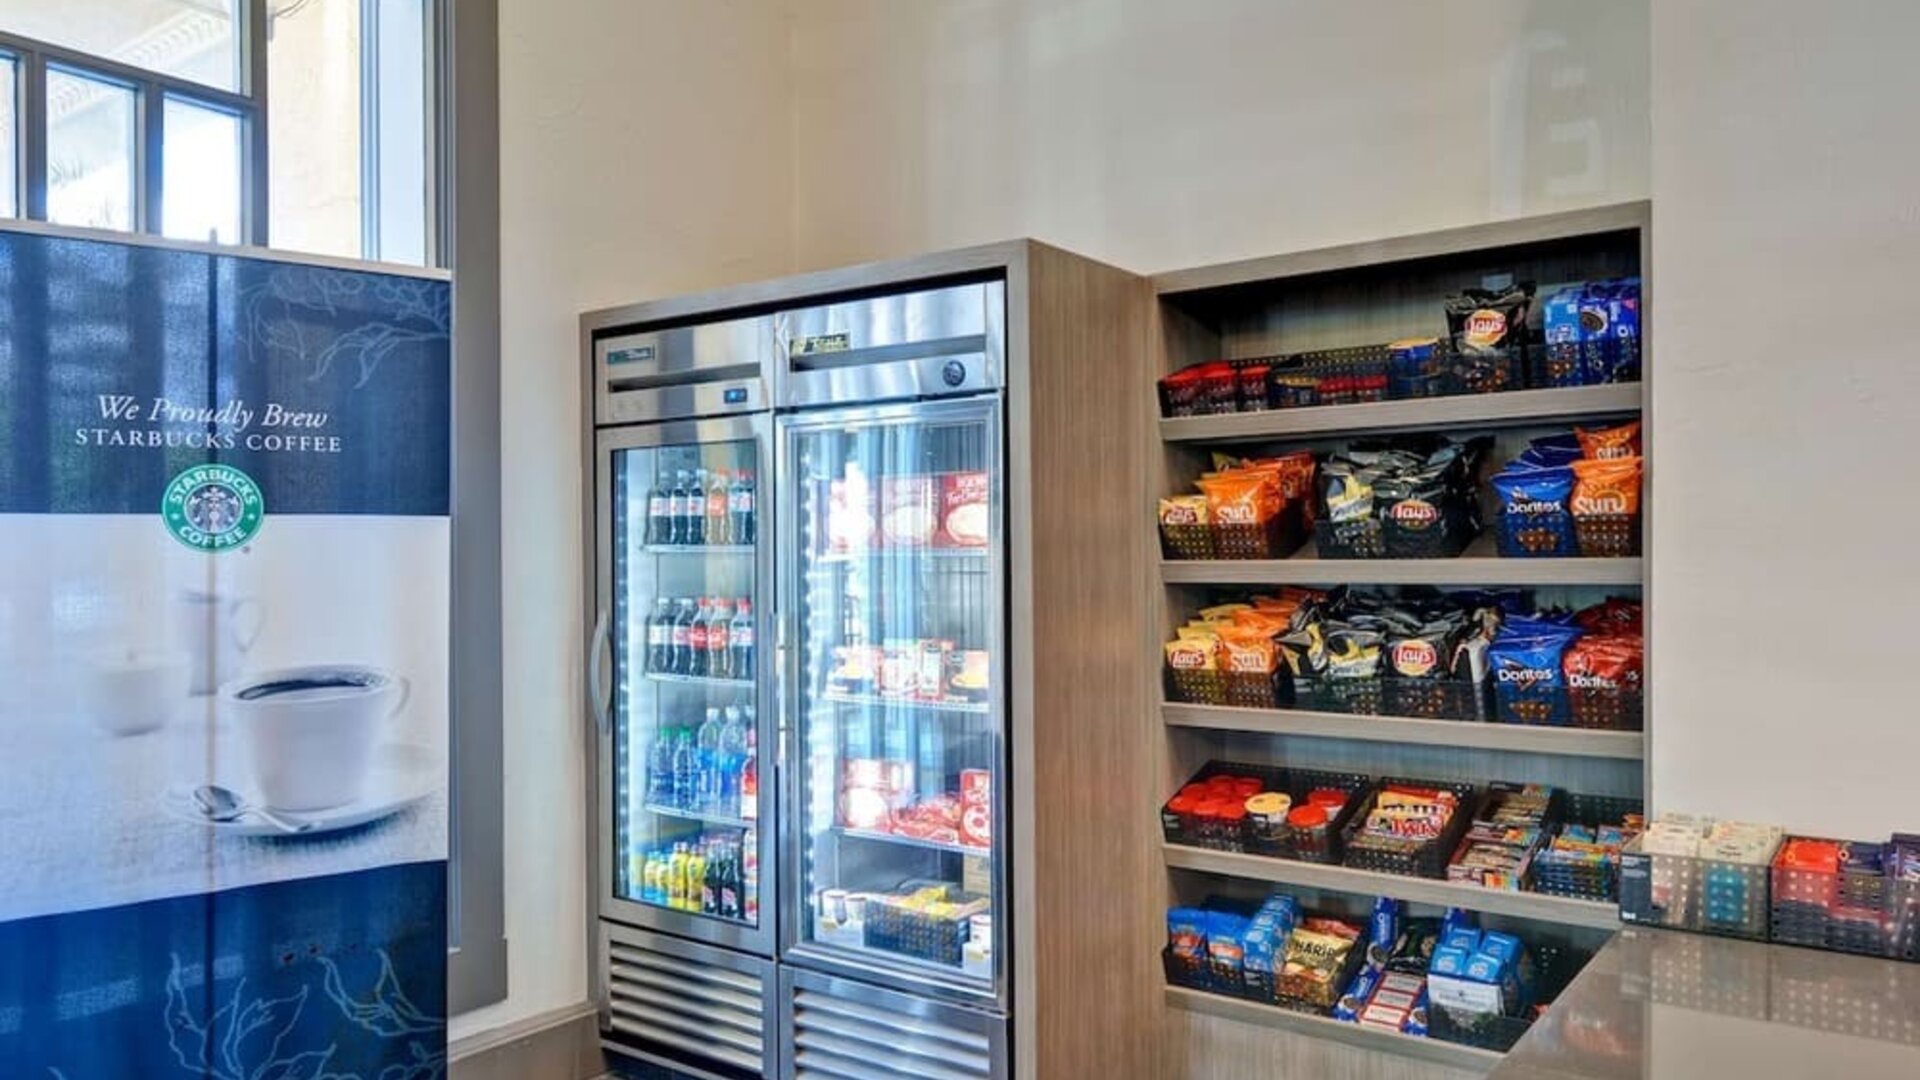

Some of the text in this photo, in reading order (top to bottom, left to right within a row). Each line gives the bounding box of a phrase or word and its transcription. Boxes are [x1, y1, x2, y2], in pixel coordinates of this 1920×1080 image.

[98, 394, 328, 433] We Proudly Brew
[75, 428, 342, 453] STARBUCKS COFFEE
[168, 468, 259, 506] STARBUCKS
[1506, 500, 1561, 515] Doritos
[179, 526, 247, 548] COFFEE
[1499, 668, 1552, 682] Doritos
